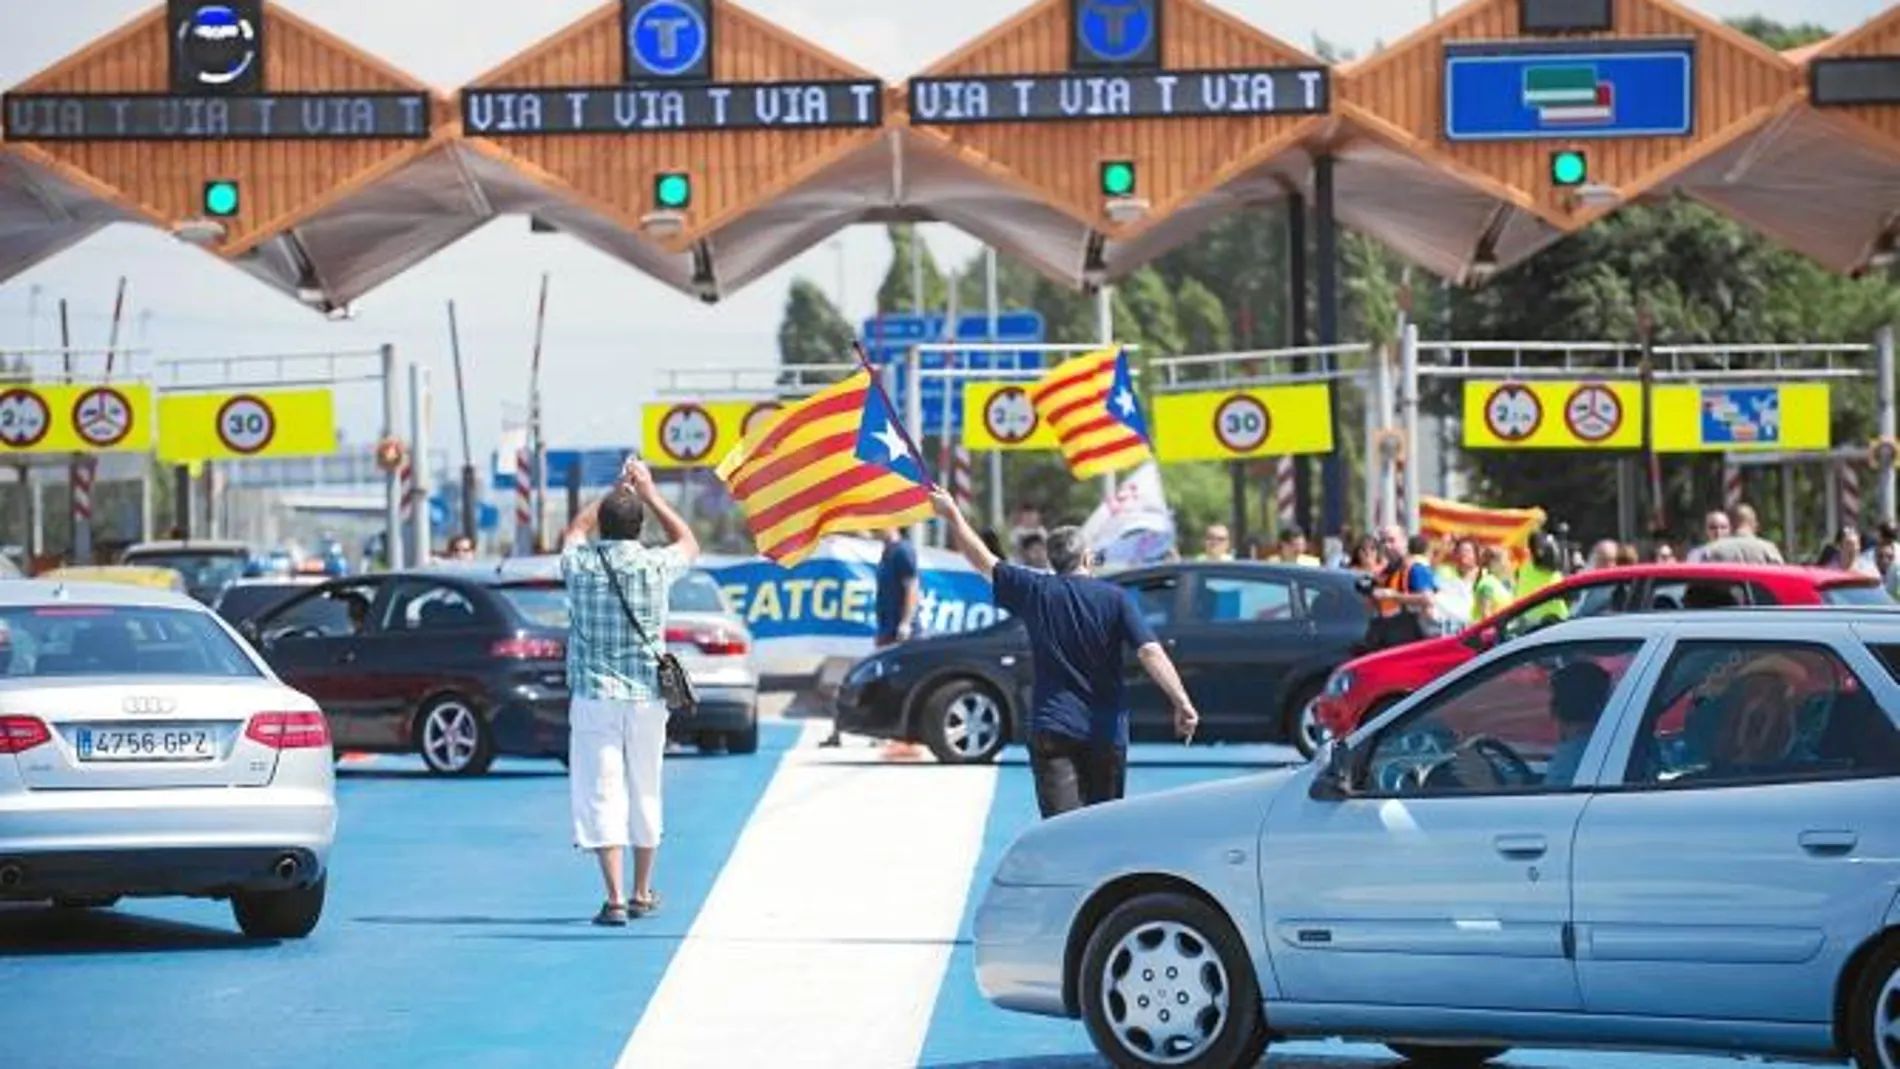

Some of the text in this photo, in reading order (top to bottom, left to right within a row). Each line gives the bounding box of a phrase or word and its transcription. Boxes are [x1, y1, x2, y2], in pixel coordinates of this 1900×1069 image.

[469, 84, 875, 130] VIA T VIA T VIA T
[915, 71, 1321, 118] VIA T VIA T VIA T
[109, 100, 130, 134] T
[255, 99, 276, 134] T
[398, 97, 421, 133] T
[229, 413, 263, 435] 30
[1226, 411, 1260, 434] 30
[96, 732, 155, 754] 4756
